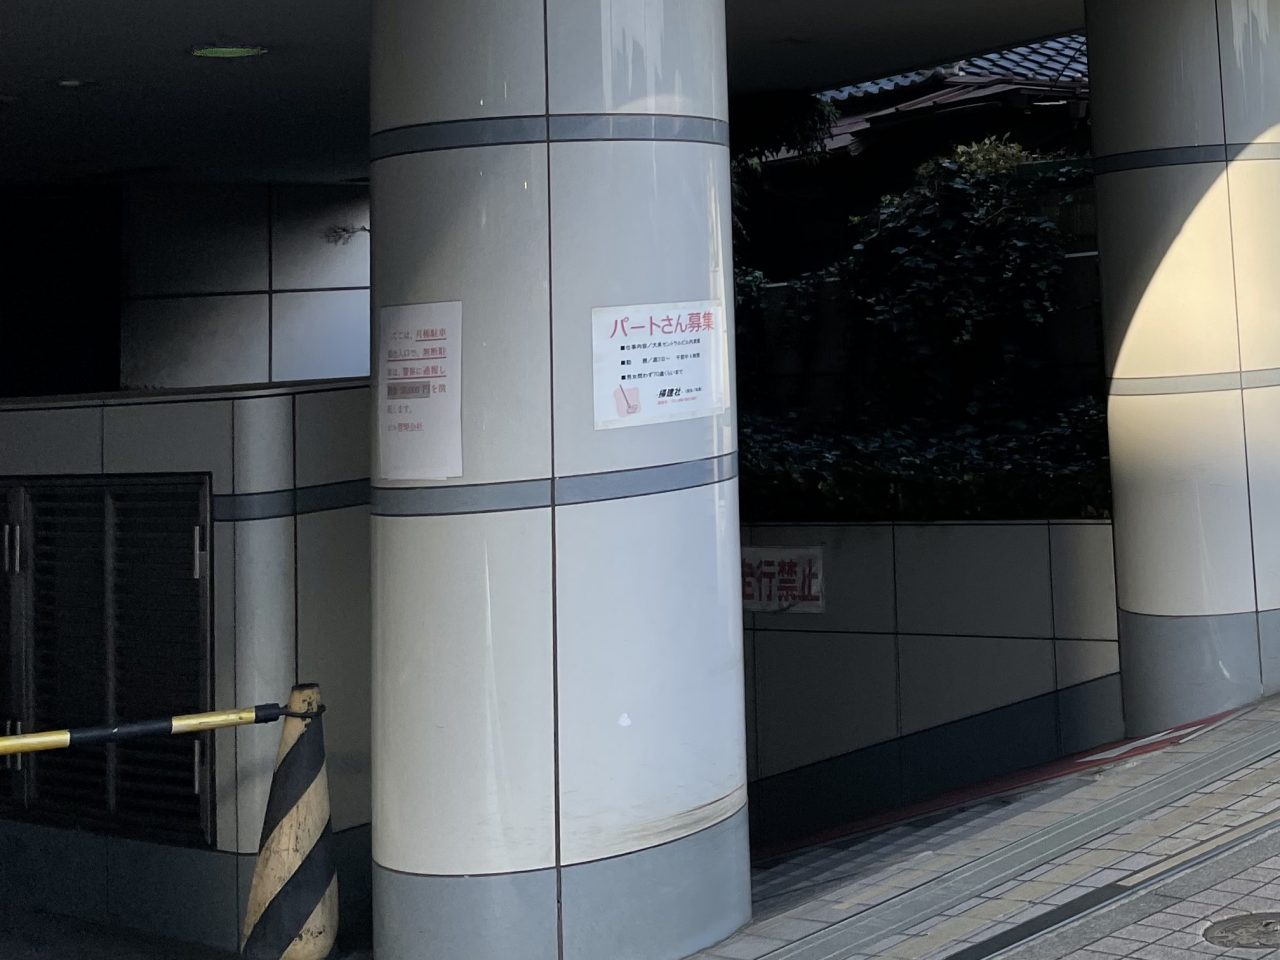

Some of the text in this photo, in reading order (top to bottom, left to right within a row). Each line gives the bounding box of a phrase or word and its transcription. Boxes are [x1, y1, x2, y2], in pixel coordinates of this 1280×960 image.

[609, 311, 715, 339] パートさん募集
